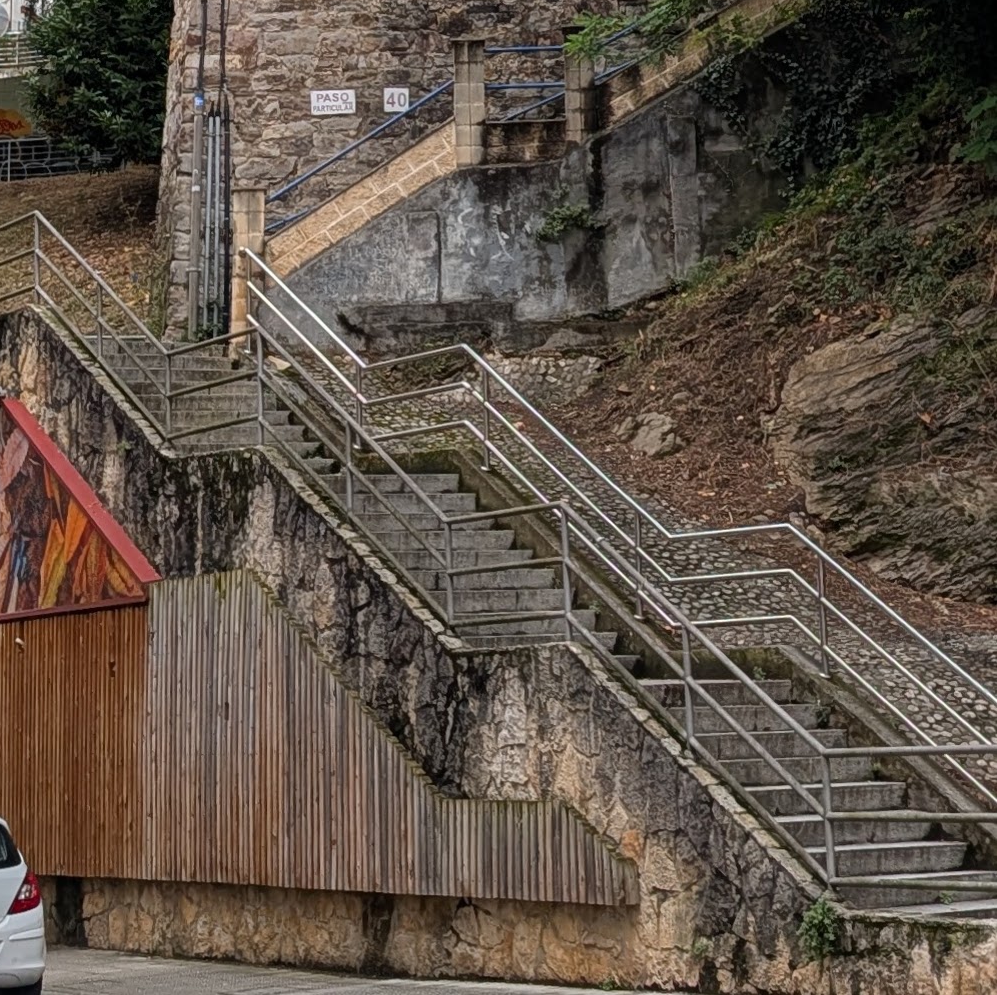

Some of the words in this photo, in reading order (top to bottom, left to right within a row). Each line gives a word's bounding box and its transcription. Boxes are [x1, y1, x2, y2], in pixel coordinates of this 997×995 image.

[316, 92, 349, 102] PASO
[386, 92, 407, 107] 40
[312, 104, 354, 112] PARTICULAR
